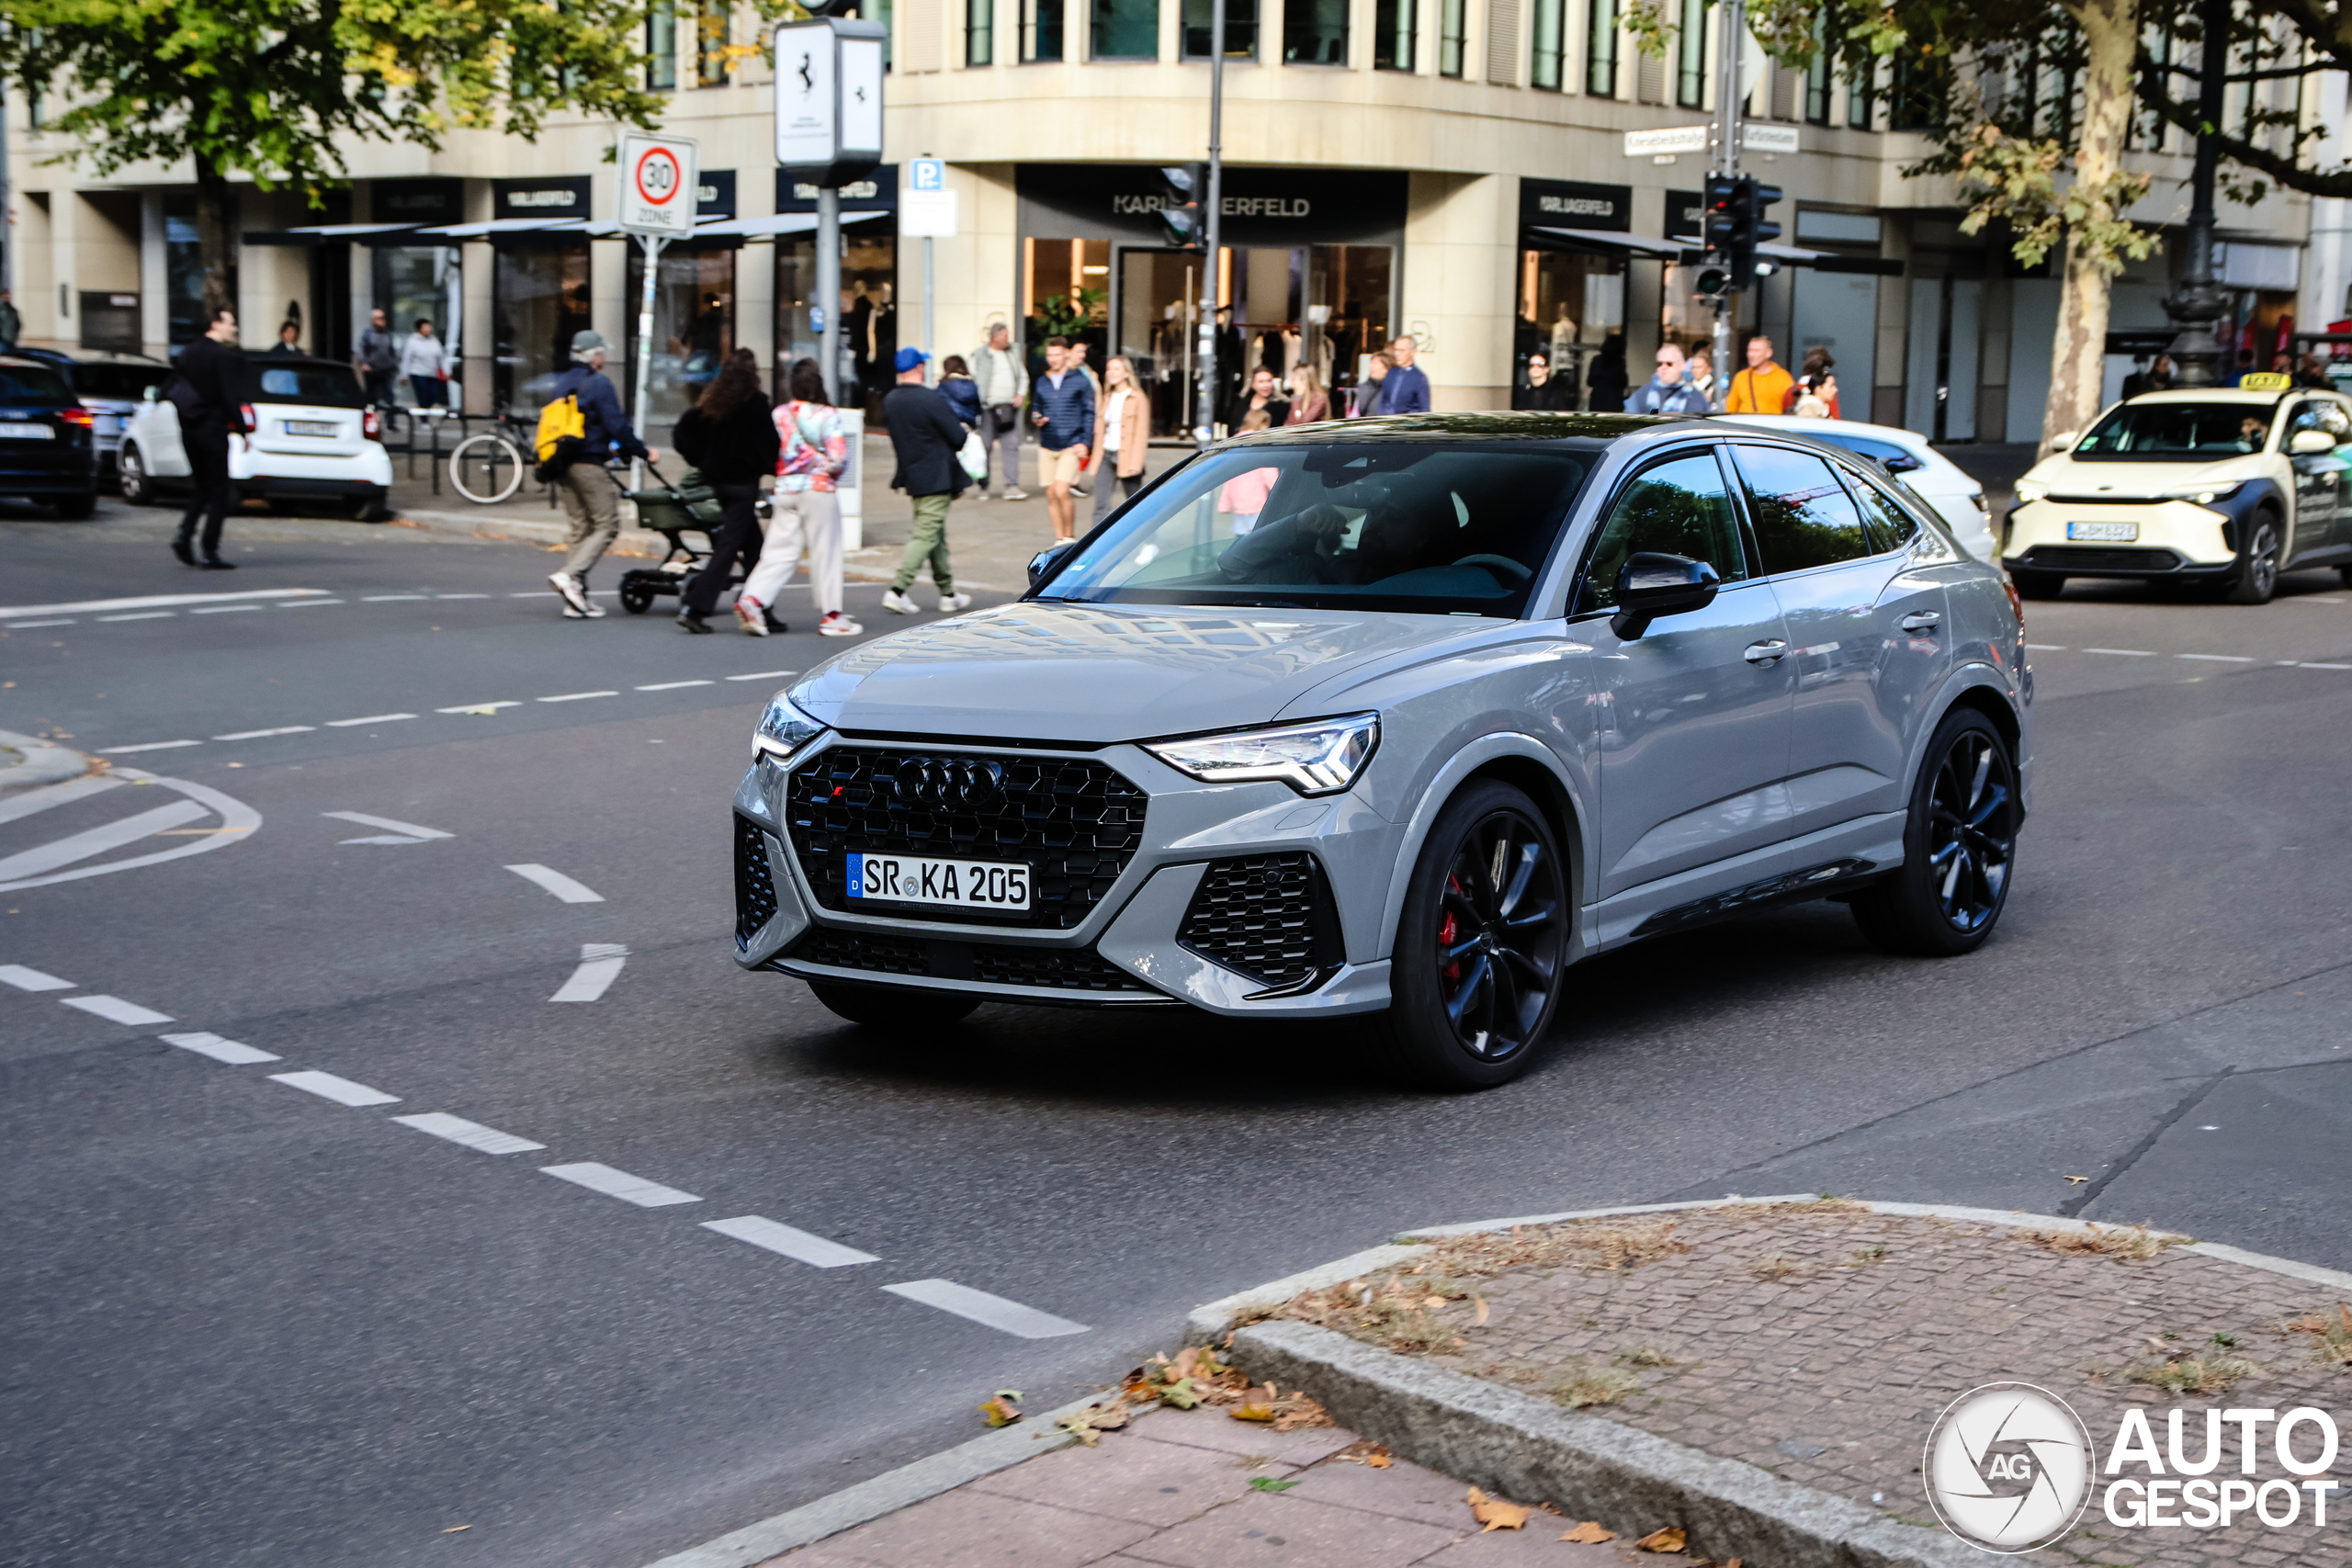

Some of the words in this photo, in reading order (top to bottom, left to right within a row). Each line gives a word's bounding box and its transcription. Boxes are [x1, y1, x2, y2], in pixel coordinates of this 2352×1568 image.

[645, 163, 673, 189] 30
[1220, 197, 1310, 217] ERFELD
[852, 880, 859, 890] D
[865, 859, 900, 895] SR
[922, 863, 960, 899] KA
[969, 866, 1026, 904] 205
